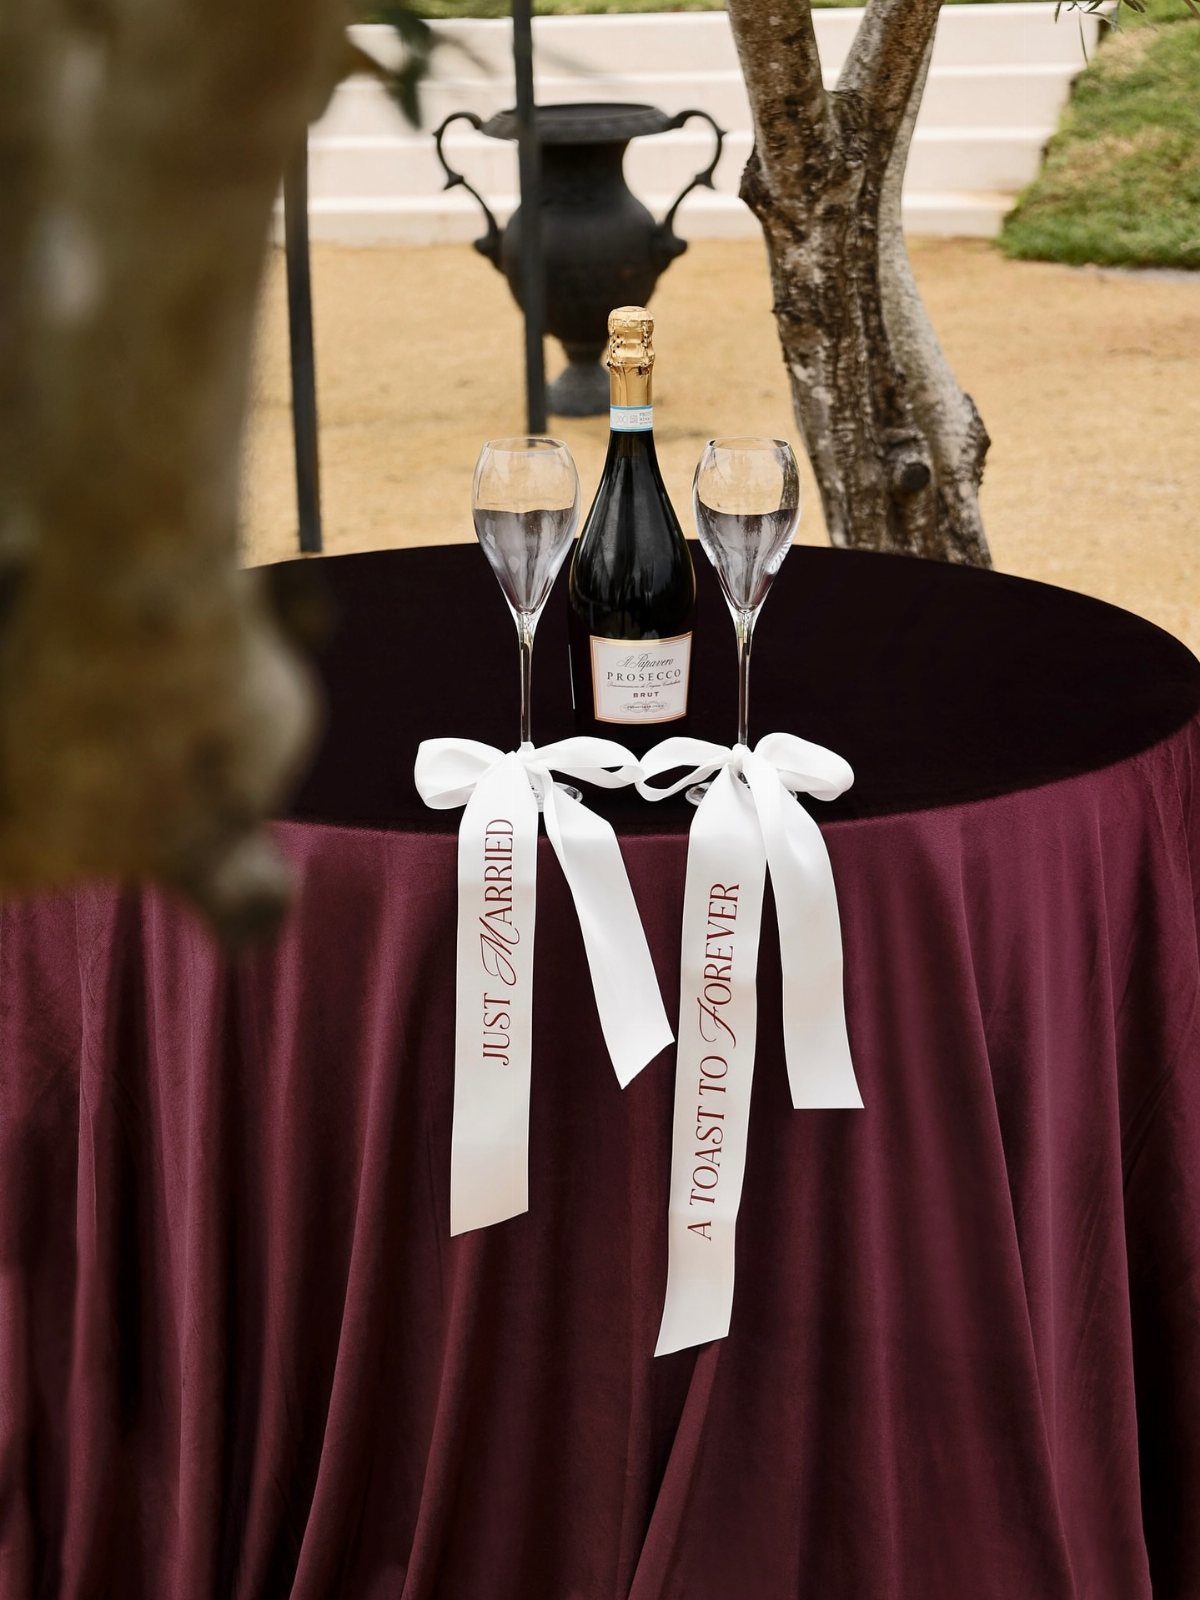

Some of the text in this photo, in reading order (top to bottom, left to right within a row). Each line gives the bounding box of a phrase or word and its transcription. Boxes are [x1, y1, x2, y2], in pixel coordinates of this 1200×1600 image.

[607, 668, 681, 682] PROSECCO
[631, 653, 674, 672] Papavero
[482, 992, 512, 1066] JUST
[686, 882, 740, 1241] A TOAST TO FOREVER
